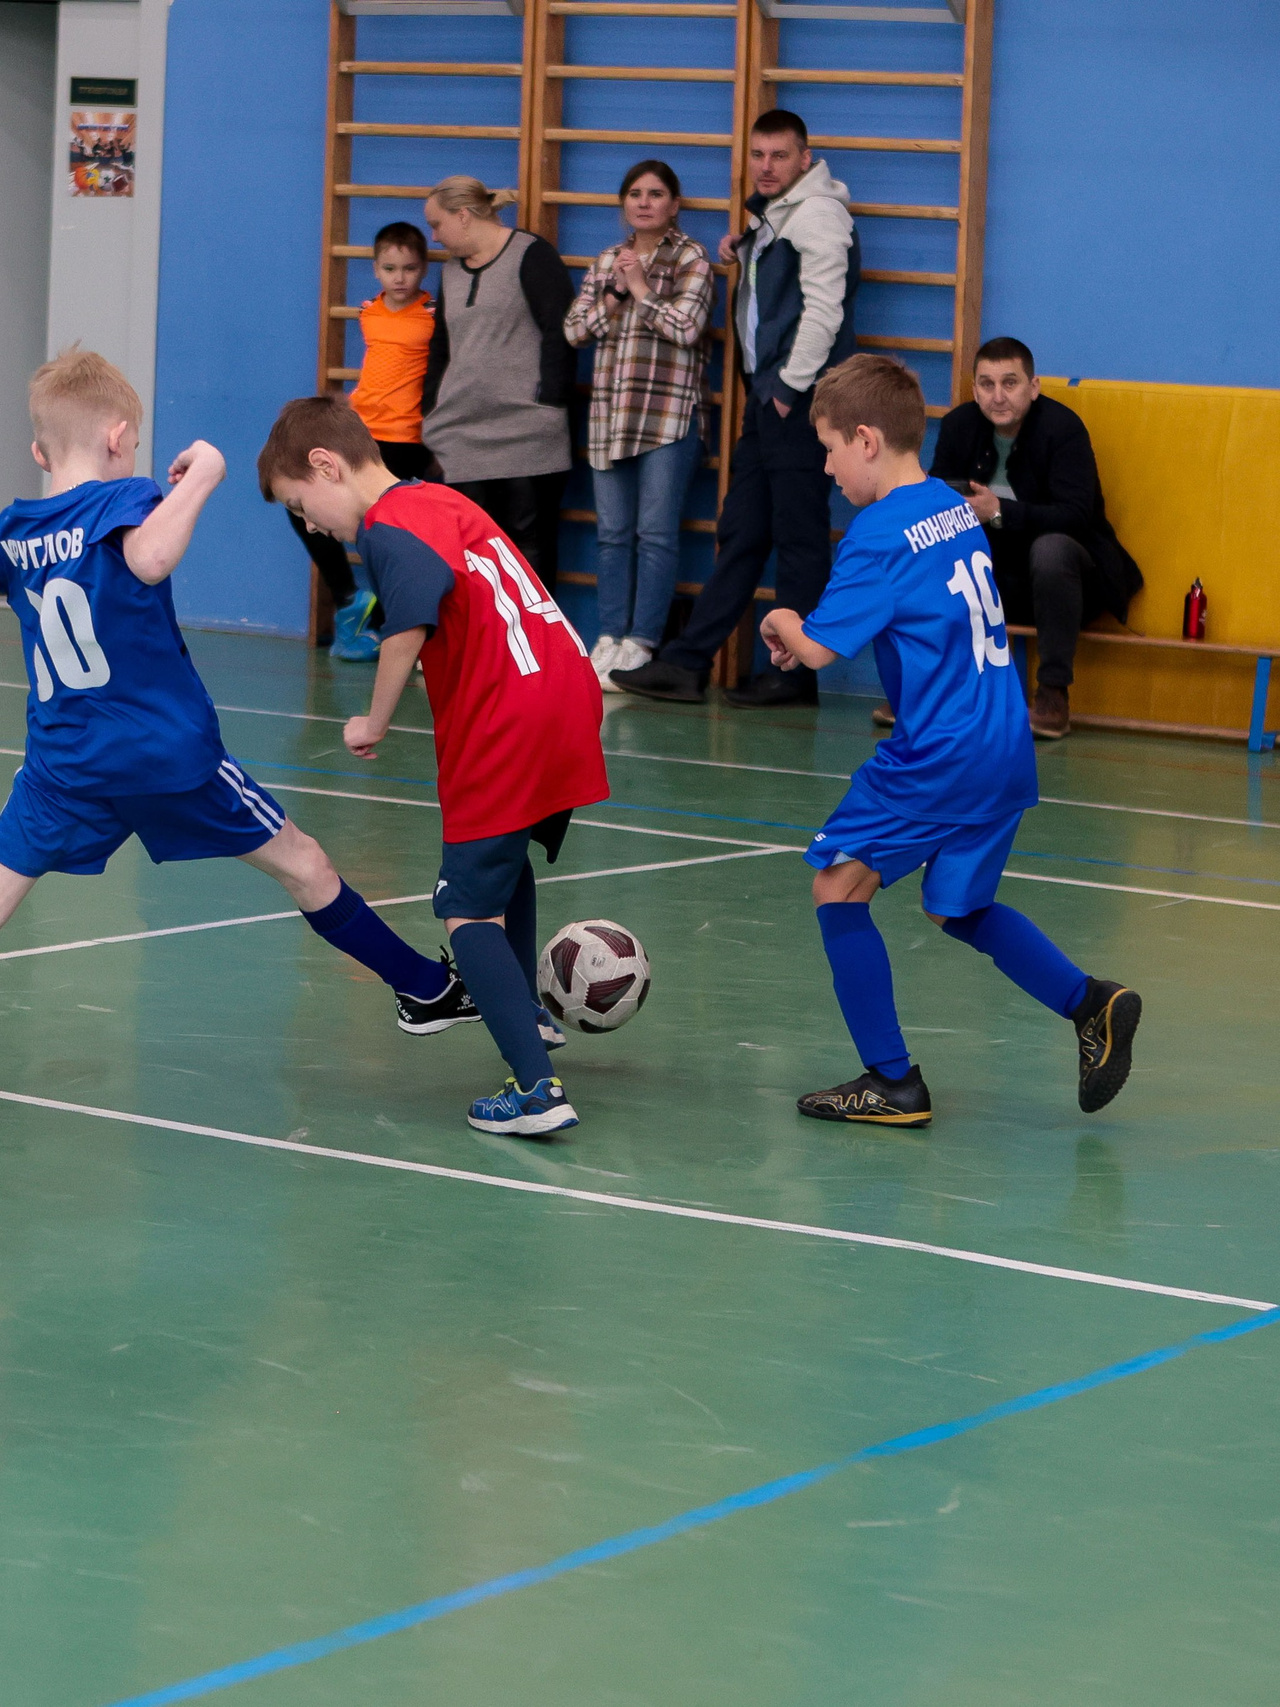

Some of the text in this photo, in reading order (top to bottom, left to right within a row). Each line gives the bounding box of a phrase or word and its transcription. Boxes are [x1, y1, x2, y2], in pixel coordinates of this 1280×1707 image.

[464, 537, 588, 676] 14
[946, 551, 1009, 675] 19
[395, 997, 412, 1021] ELME
